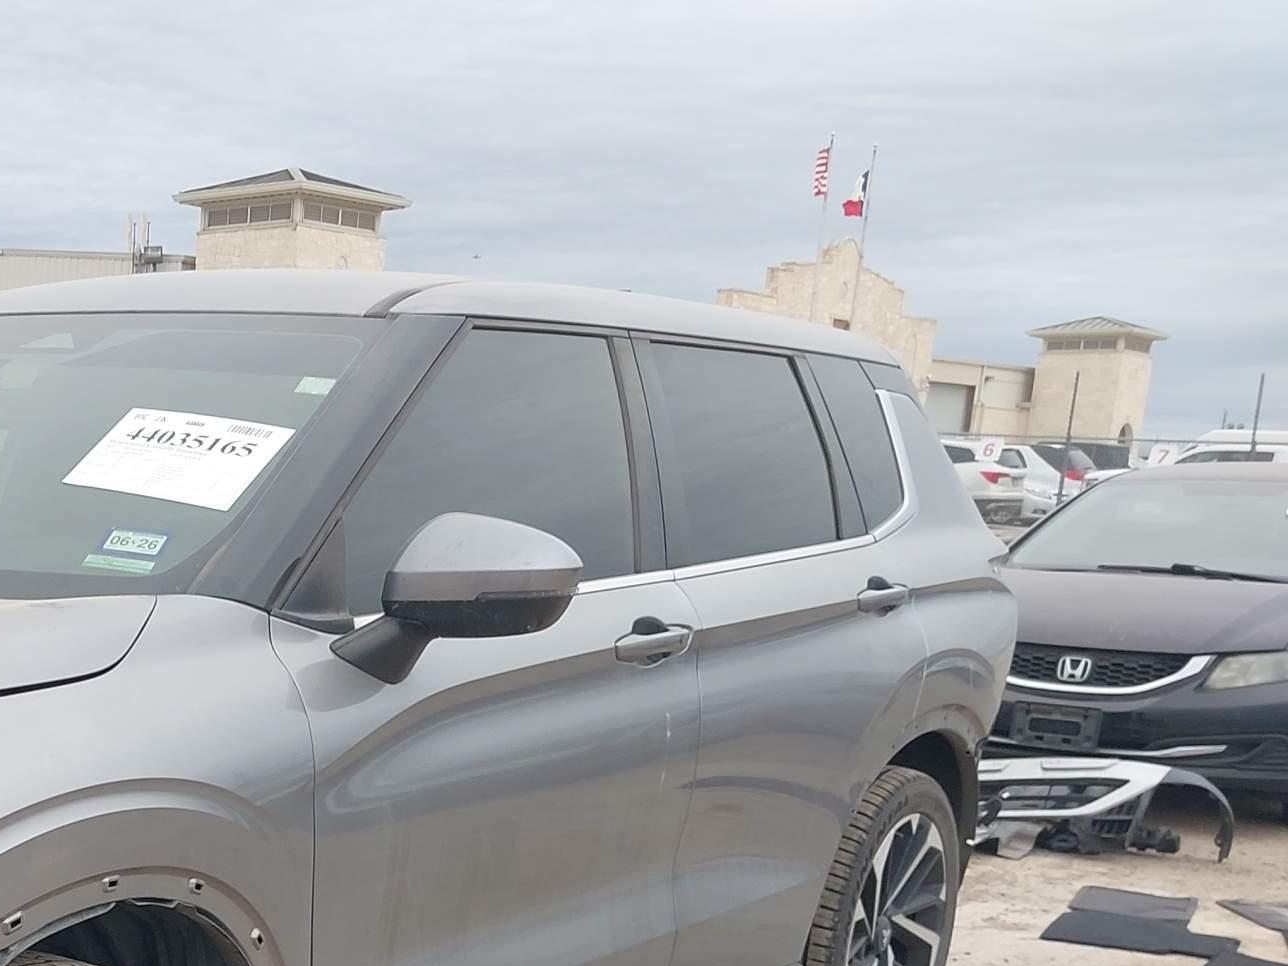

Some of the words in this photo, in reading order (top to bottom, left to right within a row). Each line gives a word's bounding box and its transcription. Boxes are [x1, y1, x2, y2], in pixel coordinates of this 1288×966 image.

[126, 426, 259, 457] 44035165
[983, 442, 995, 457] 6
[1158, 448, 1170, 464] 7
